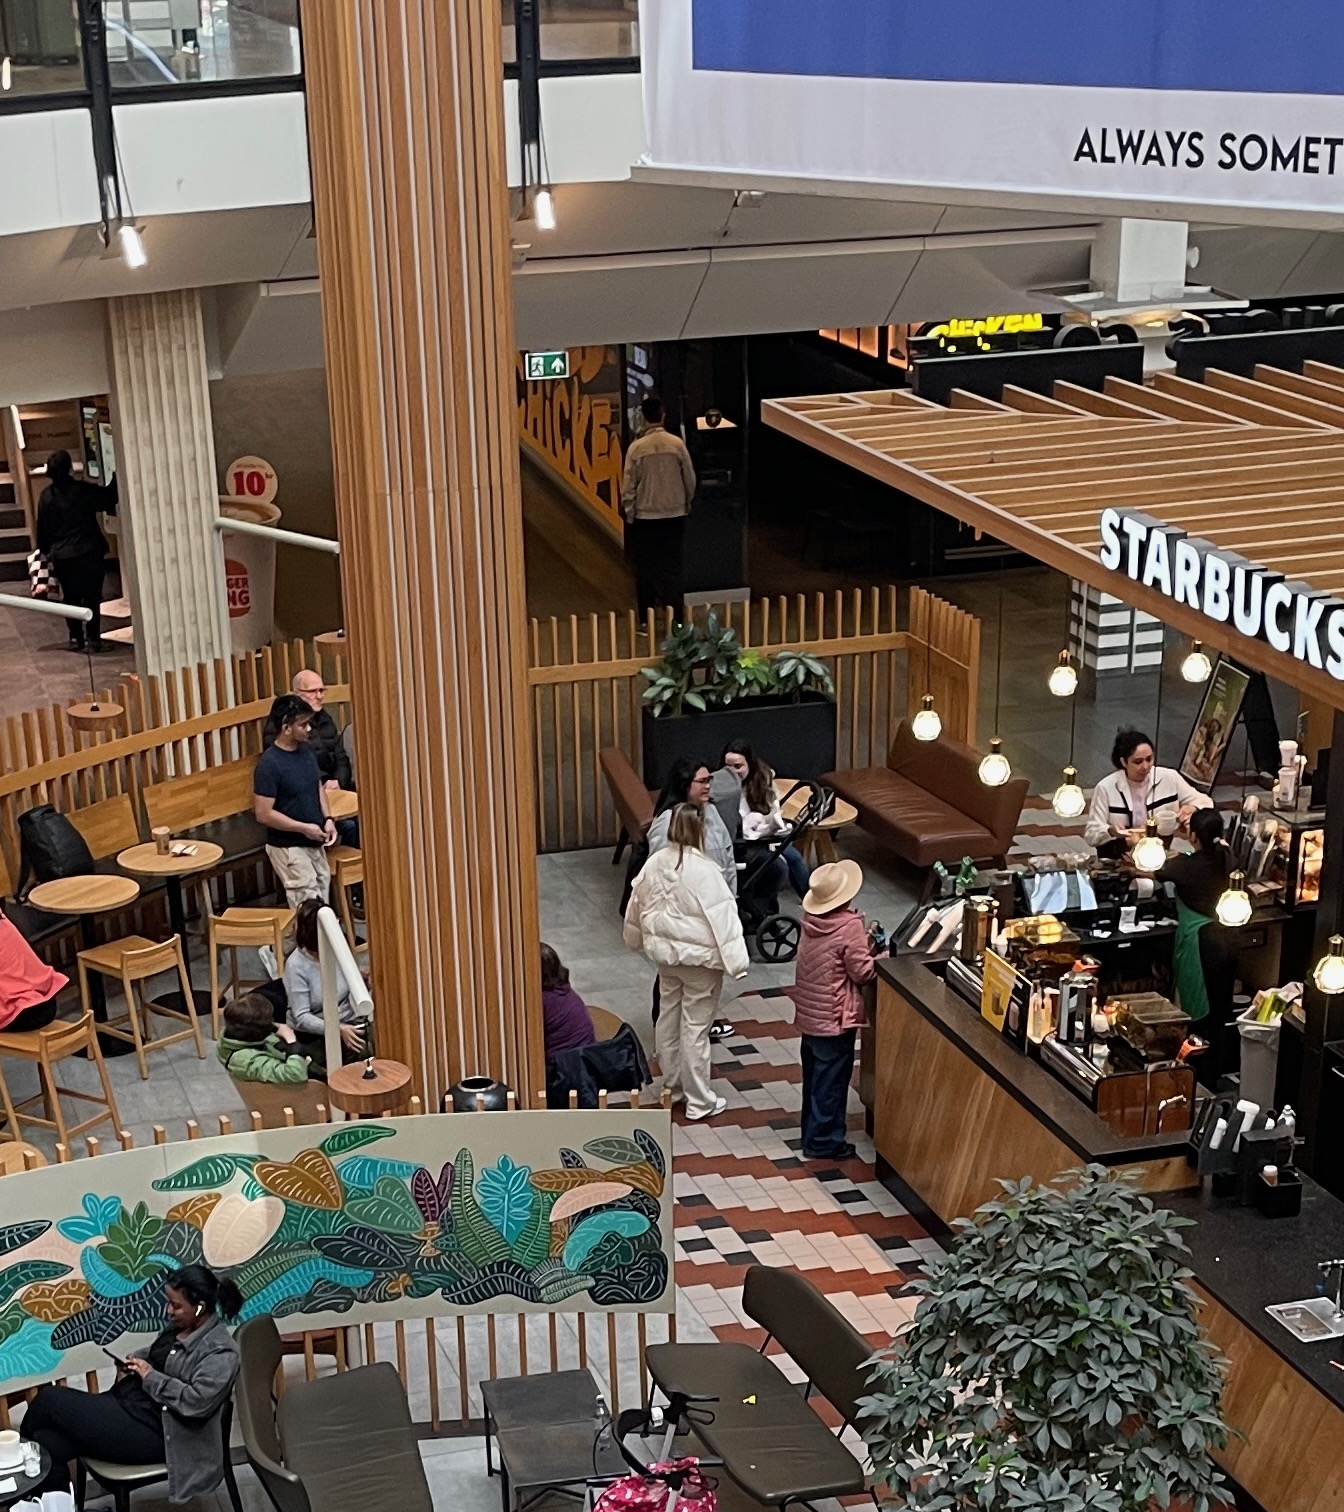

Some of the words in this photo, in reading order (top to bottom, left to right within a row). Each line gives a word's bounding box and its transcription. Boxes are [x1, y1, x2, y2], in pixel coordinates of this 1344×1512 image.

[1073, 127, 1205, 169] ALWAYS
[233, 470, 265, 497] 10
[226, 577, 249, 589] GER
[228, 590, 250, 607] NG
